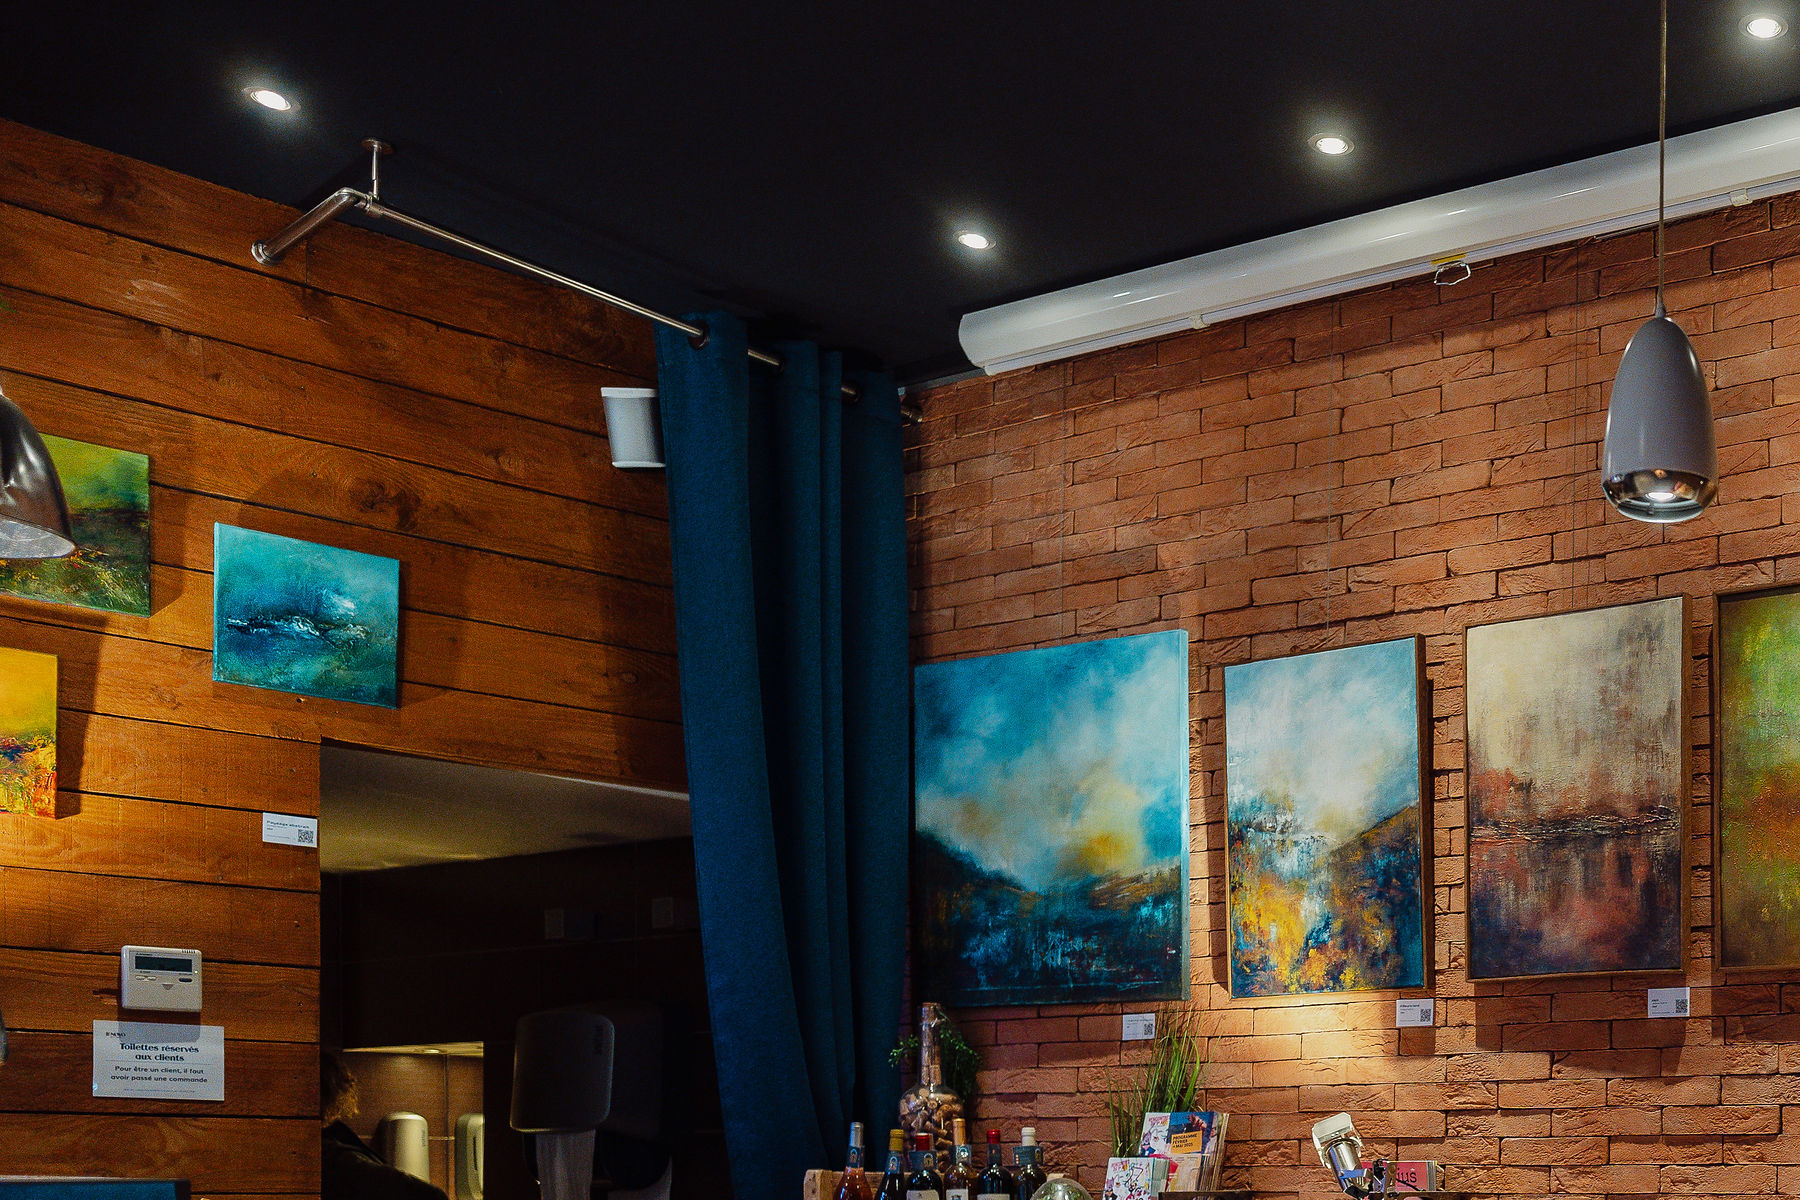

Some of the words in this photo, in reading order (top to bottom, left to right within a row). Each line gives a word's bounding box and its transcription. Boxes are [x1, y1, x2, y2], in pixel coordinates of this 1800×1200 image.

[120, 1042, 159, 1052] Toilettes
[161, 1044, 200, 1053] réservés
[154, 1053, 185, 1062] clients
[133, 1065, 148, 1073] être
[131, 1074, 152, 1082] passé
[1172, 1133, 1198, 1141] PROGRAMME
